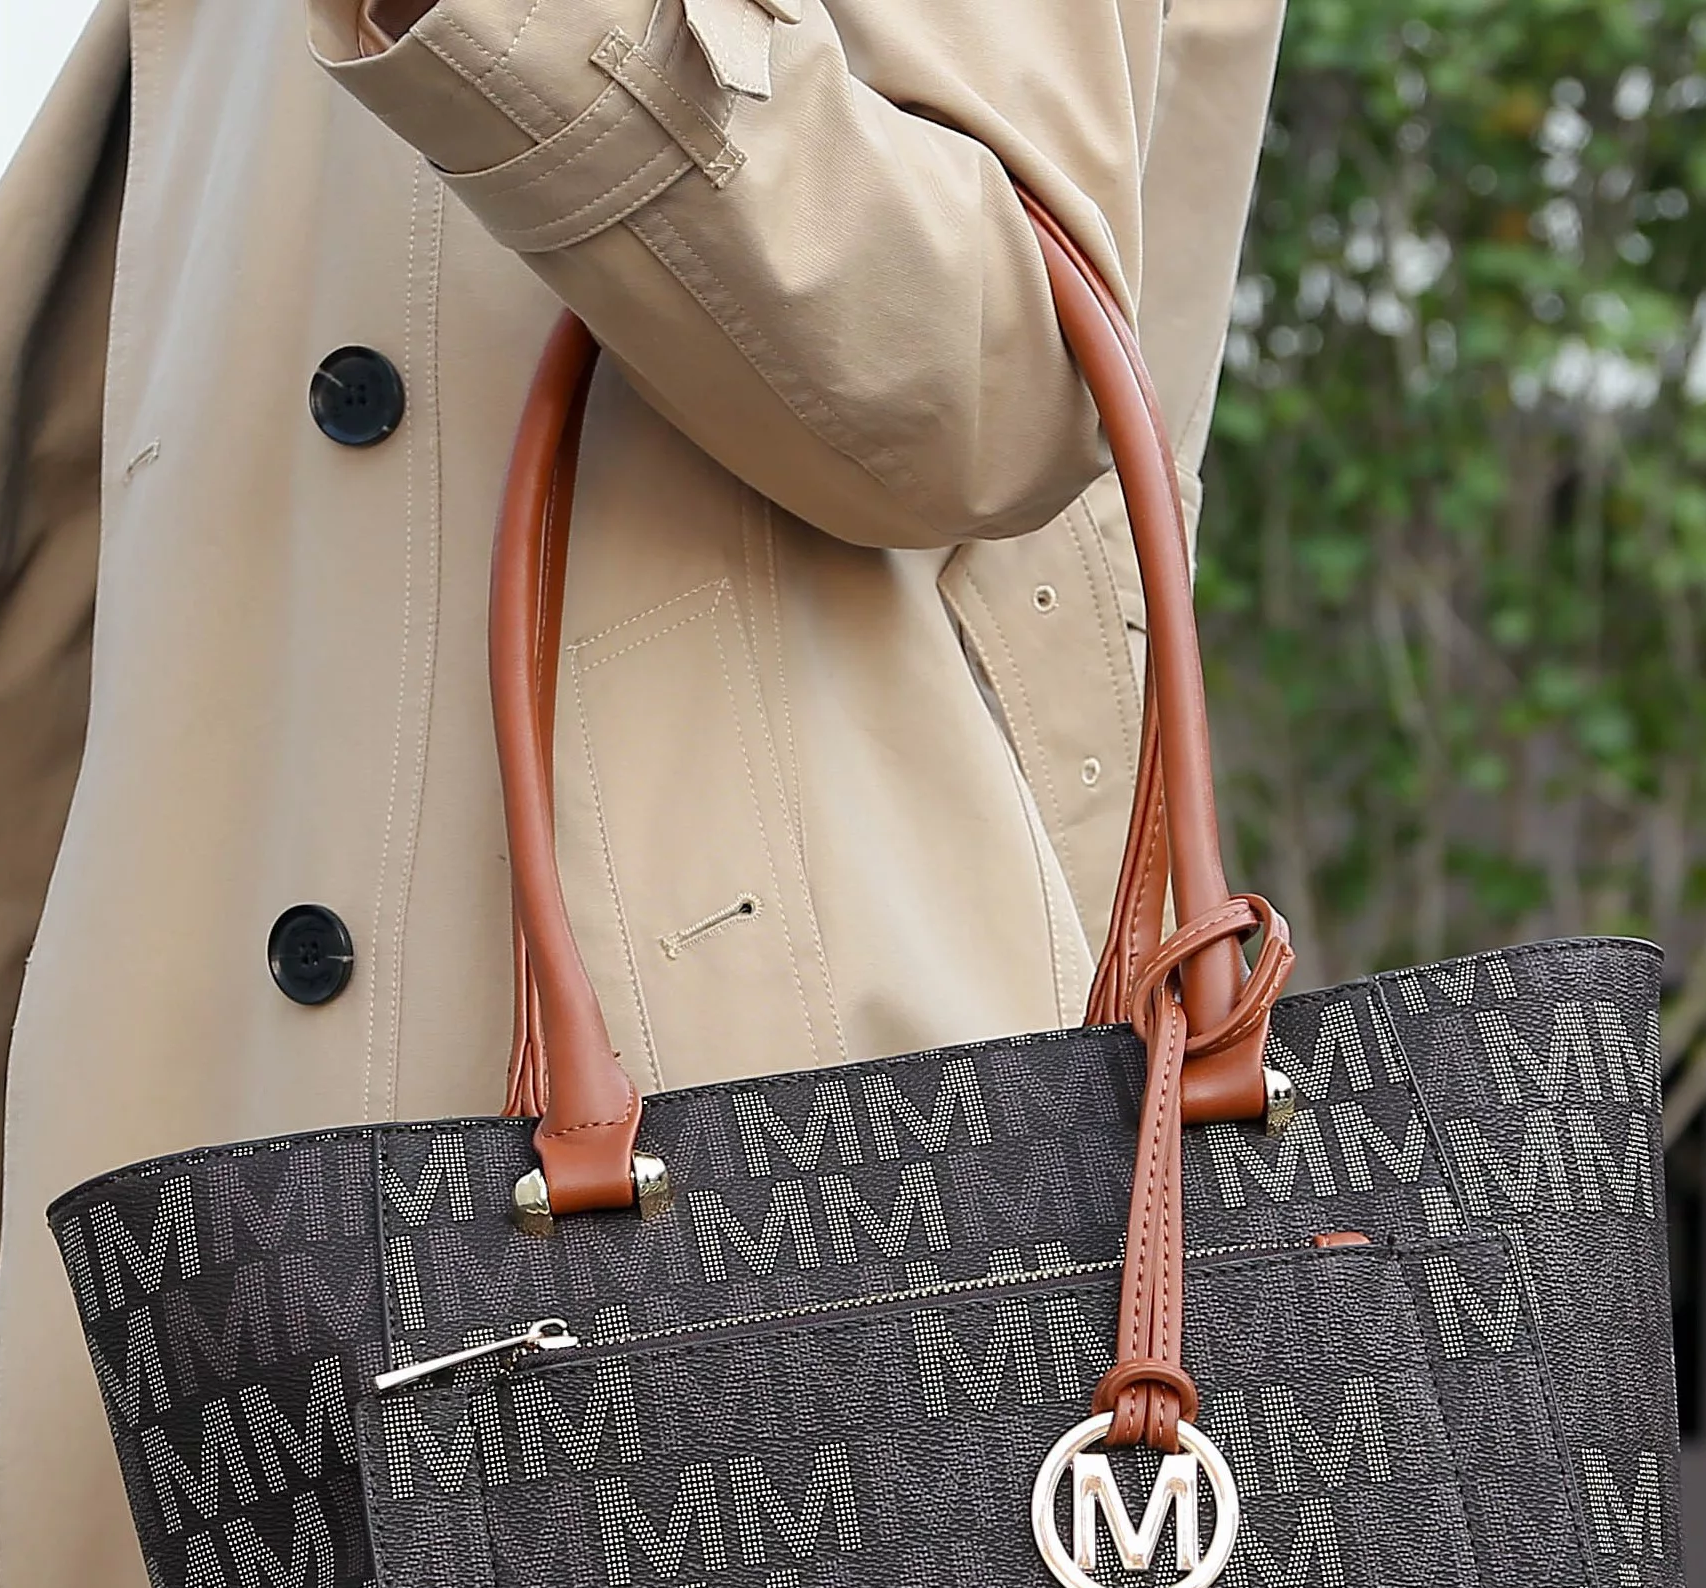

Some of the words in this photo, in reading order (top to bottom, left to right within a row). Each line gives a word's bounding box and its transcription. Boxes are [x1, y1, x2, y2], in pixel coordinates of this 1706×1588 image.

[733, 1058, 992, 1177] MM
[688, 1162, 951, 1282] MM
[141, 1354, 357, 1535] MM
[381, 1354, 642, 1499] MM
[595, 1442, 861, 1585] MM
